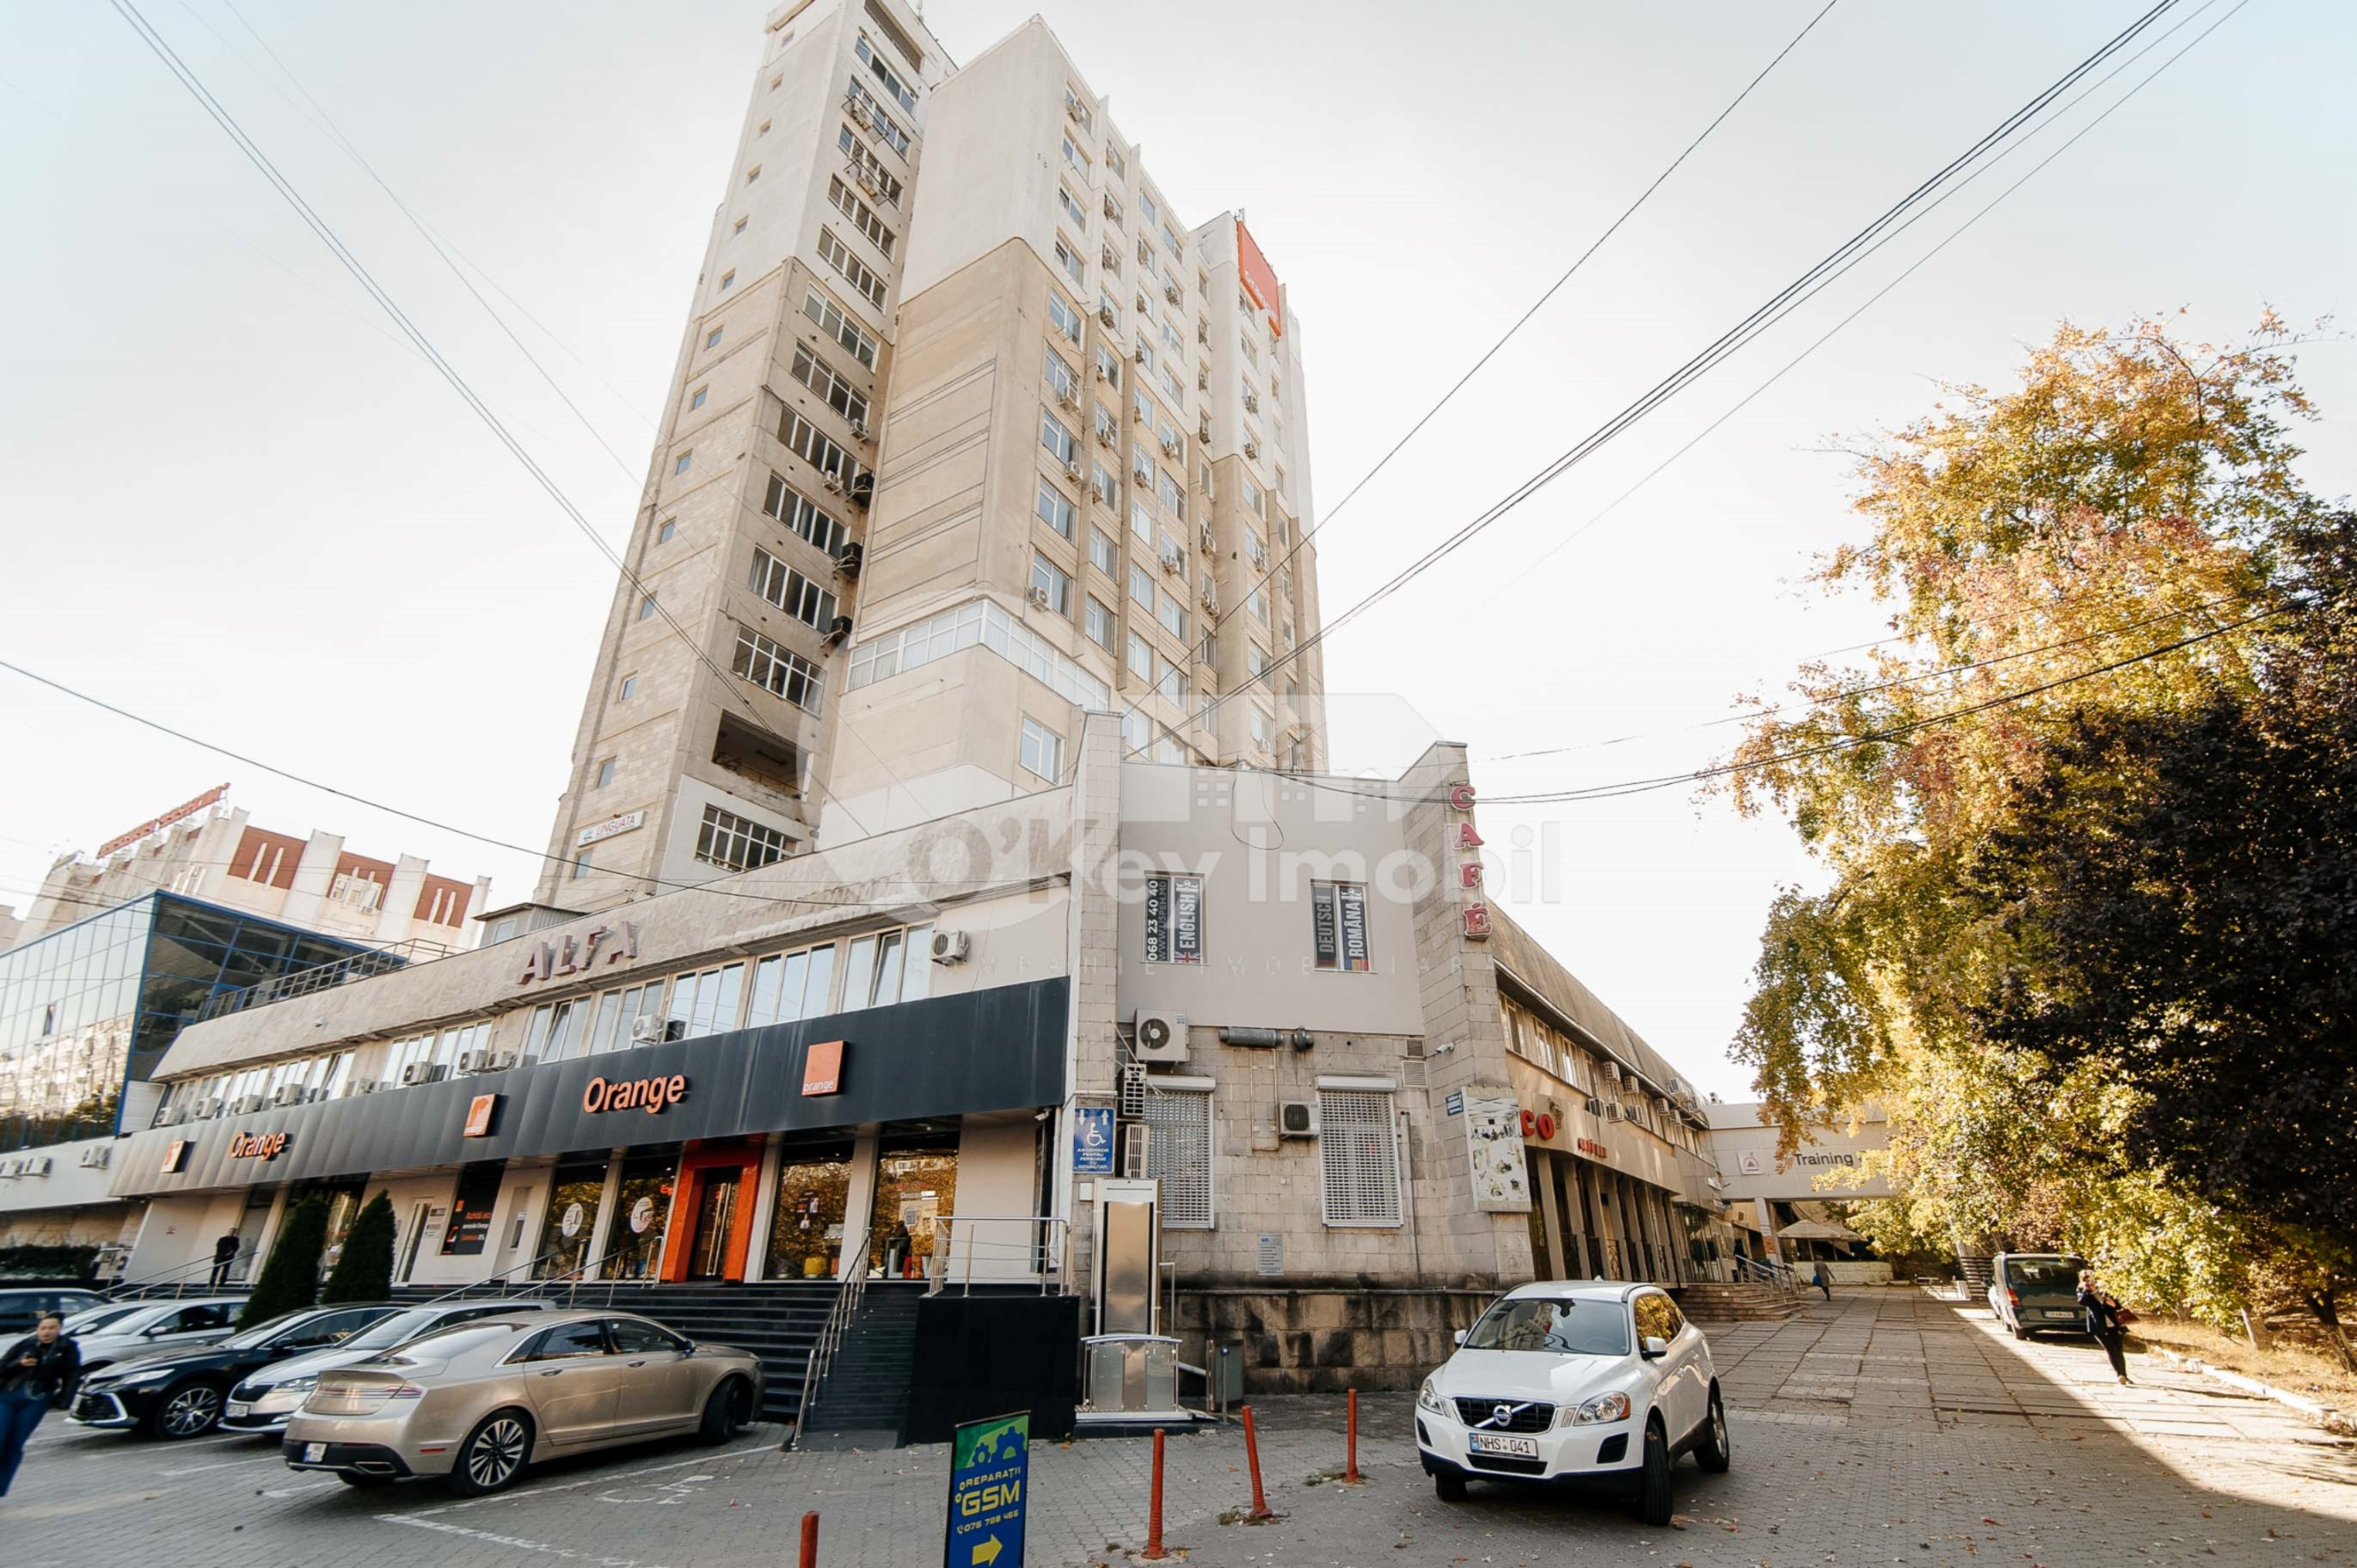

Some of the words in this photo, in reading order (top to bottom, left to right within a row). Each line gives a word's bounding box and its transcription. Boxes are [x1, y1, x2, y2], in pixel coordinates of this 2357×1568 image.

[1450, 785, 1493, 935] CAFÉ
[1149, 880, 1158, 896] 40
[1149, 899, 1158, 916] 40
[1179, 894, 1195, 948] ENGLISH
[1148, 919, 1157, 934] 23
[1316, 895, 1335, 952] DEUTSCH
[516, 921, 638, 985] ALFA
[1148, 937, 1157, 961] 068
[583, 1074, 685, 1114] Orange
[803, 1080, 834, 1093] orange
[230, 1130, 286, 1161] Orange
[1794, 1152, 1854, 1167] Training
[1479, 1436, 1501, 1450] NHS
[1510, 1439, 1531, 1454] 041
[961, 1479, 1021, 1516] GSM
